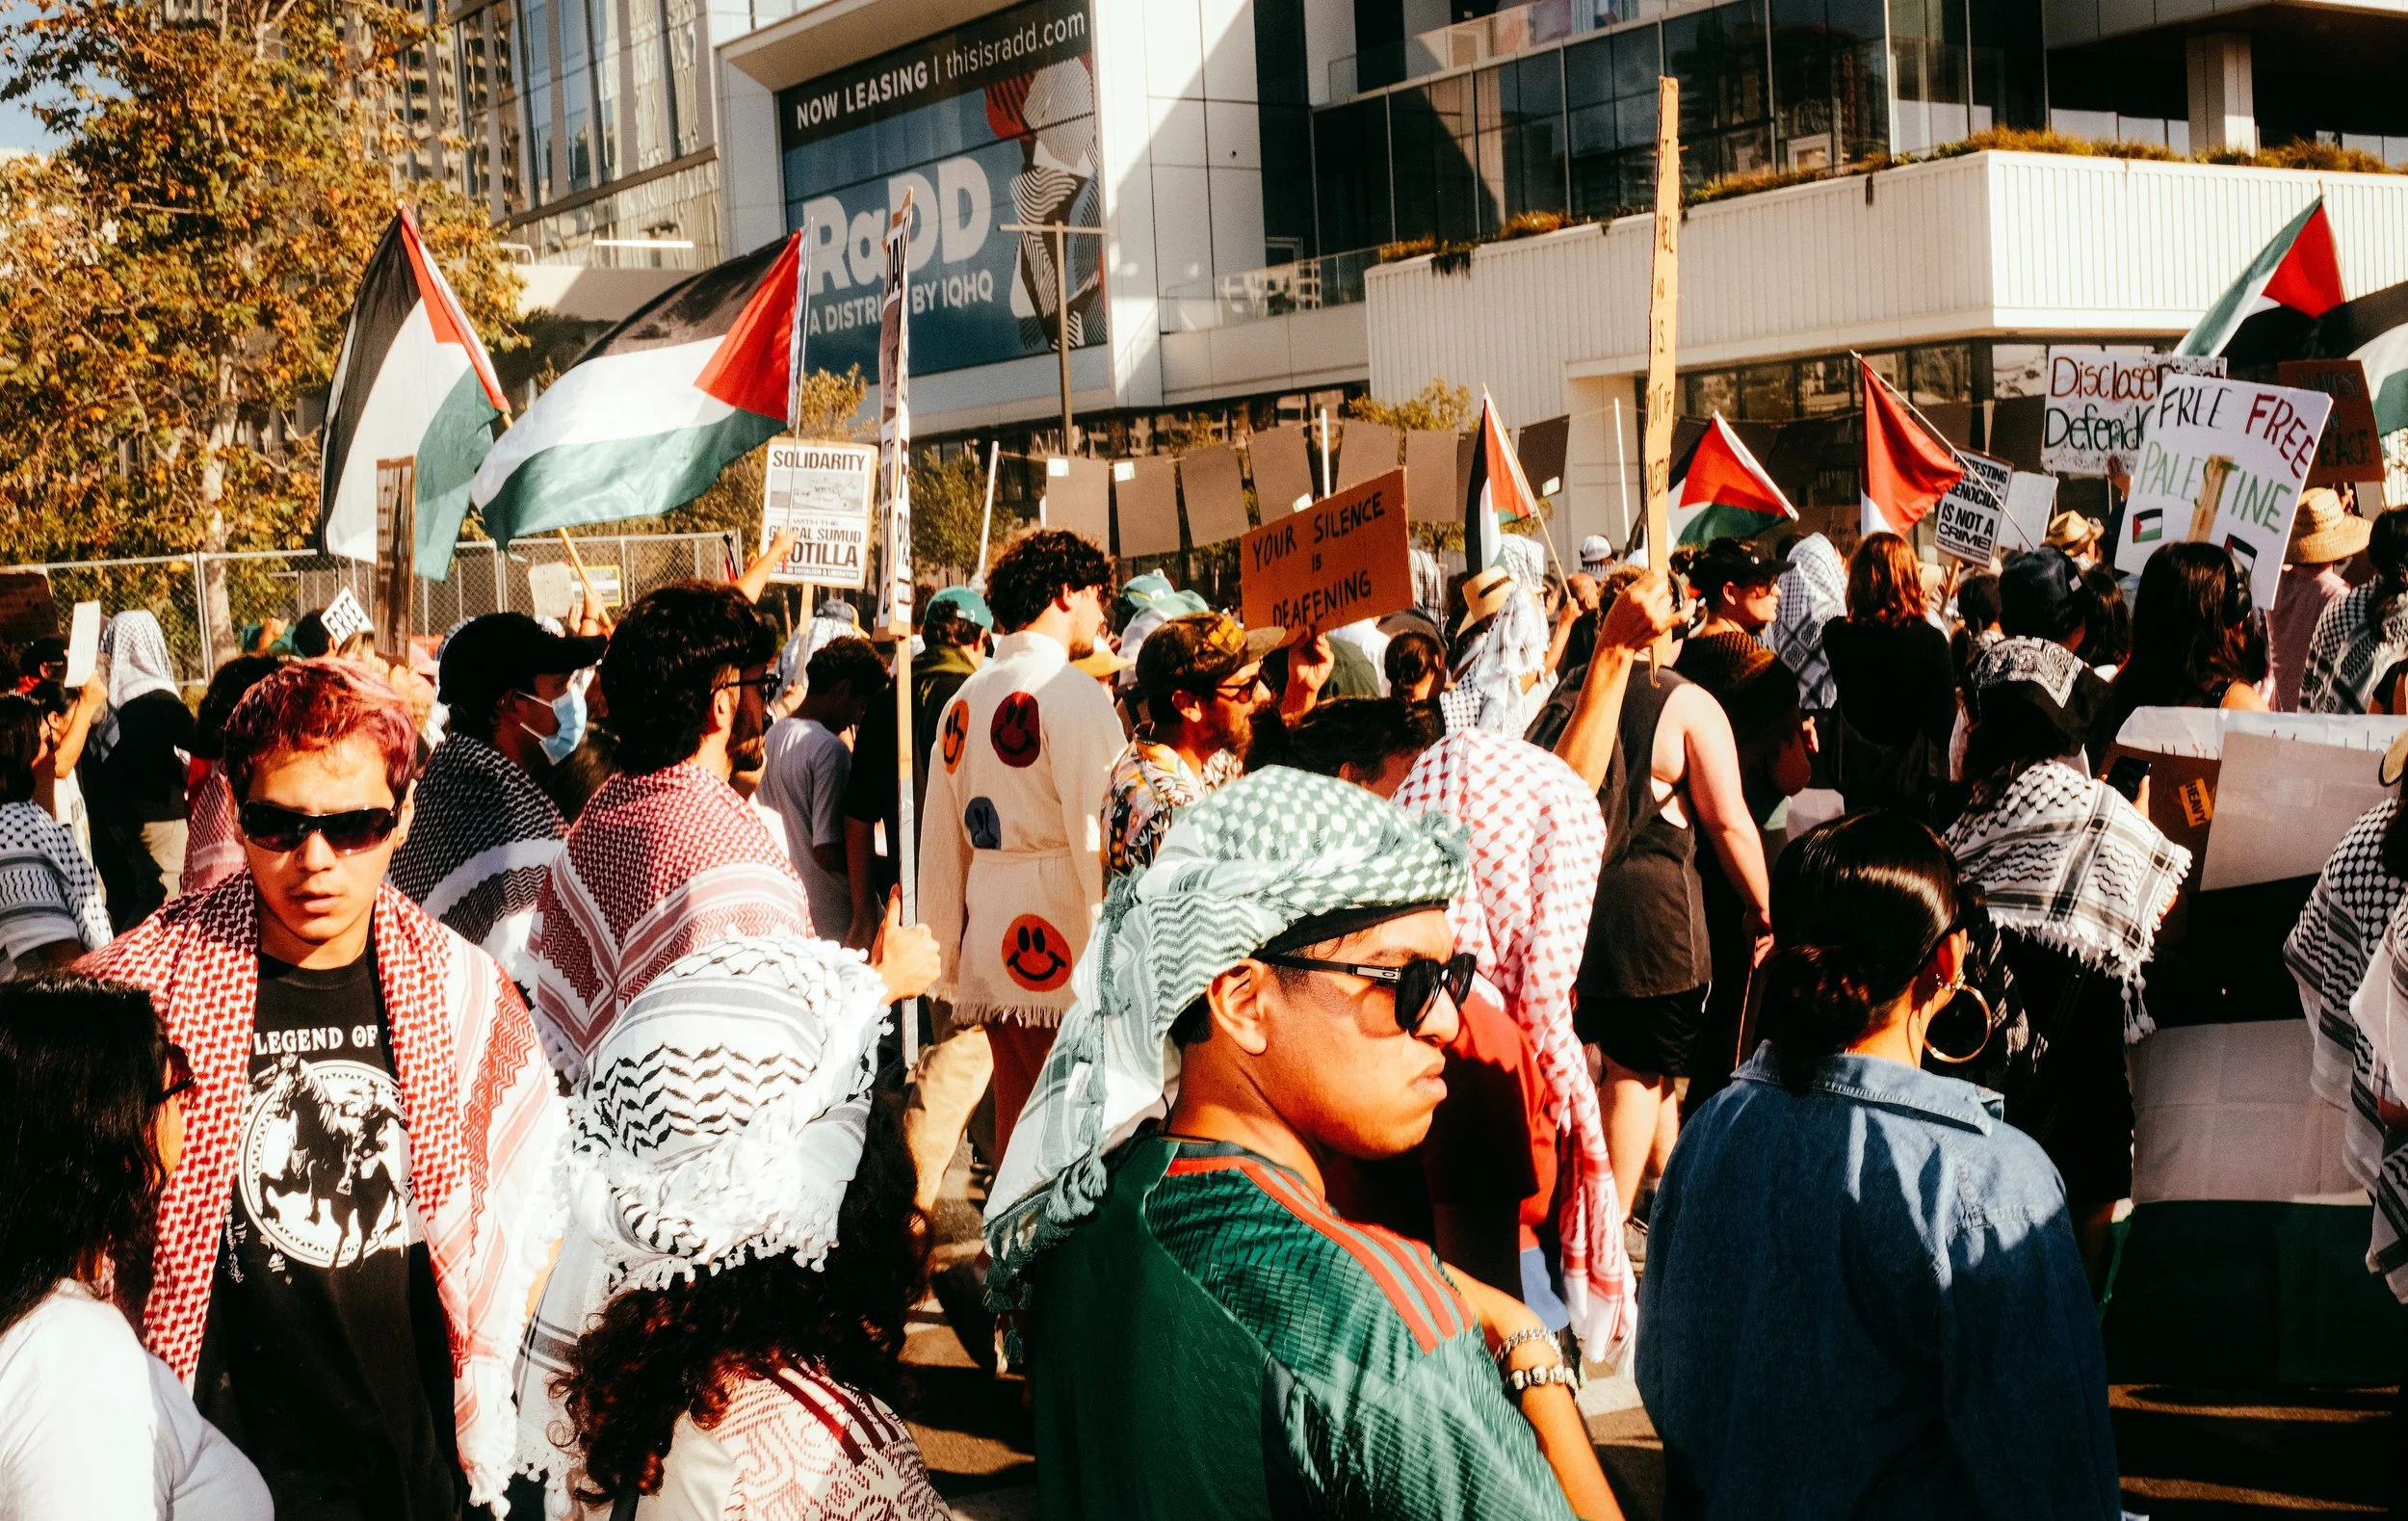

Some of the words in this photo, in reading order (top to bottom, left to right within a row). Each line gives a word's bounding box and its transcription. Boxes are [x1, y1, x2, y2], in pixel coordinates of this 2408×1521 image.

[797, 94, 839, 129] NOW
[846, 61, 929, 114] LEASING
[945, 11, 1086, 80] thisisradd.com
[808, 313, 823, 336] A
[826, 298, 884, 328] DISTRI
[913, 275, 937, 315] BY
[943, 269, 994, 307] IQHQ
[2051, 356, 2157, 401] Disclose
[2044, 404, 2140, 452] Defend
[2159, 386, 2234, 430] FREE
[2245, 393, 2315, 480] FREE
[2319, 428, 2374, 467] EACE
[772, 451, 866, 471] SOLIDARITY
[2138, 441, 2293, 535] PALESTINE
[769, 525, 814, 540] GAL
[817, 527, 862, 543] SUMUD
[1253, 525, 1296, 572] YOUR
[1314, 491, 1385, 544] SILENCE
[1938, 522, 1993, 551] CRIME!
[1941, 502, 1954, 522] IS
[1955, 506, 1983, 532] NOT
[1984, 517, 1996, 538] A
[790, 541, 858, 567] OTILLA
[1311, 553, 1322, 573] IS
[327, 596, 363, 643] FREE
[1272, 569, 1372, 629] DEAFENING
[2186, 780, 2208, 822] HEAVY
[252, 1027, 344, 1056] LEGEND
[352, 1024, 379, 1048] OF
